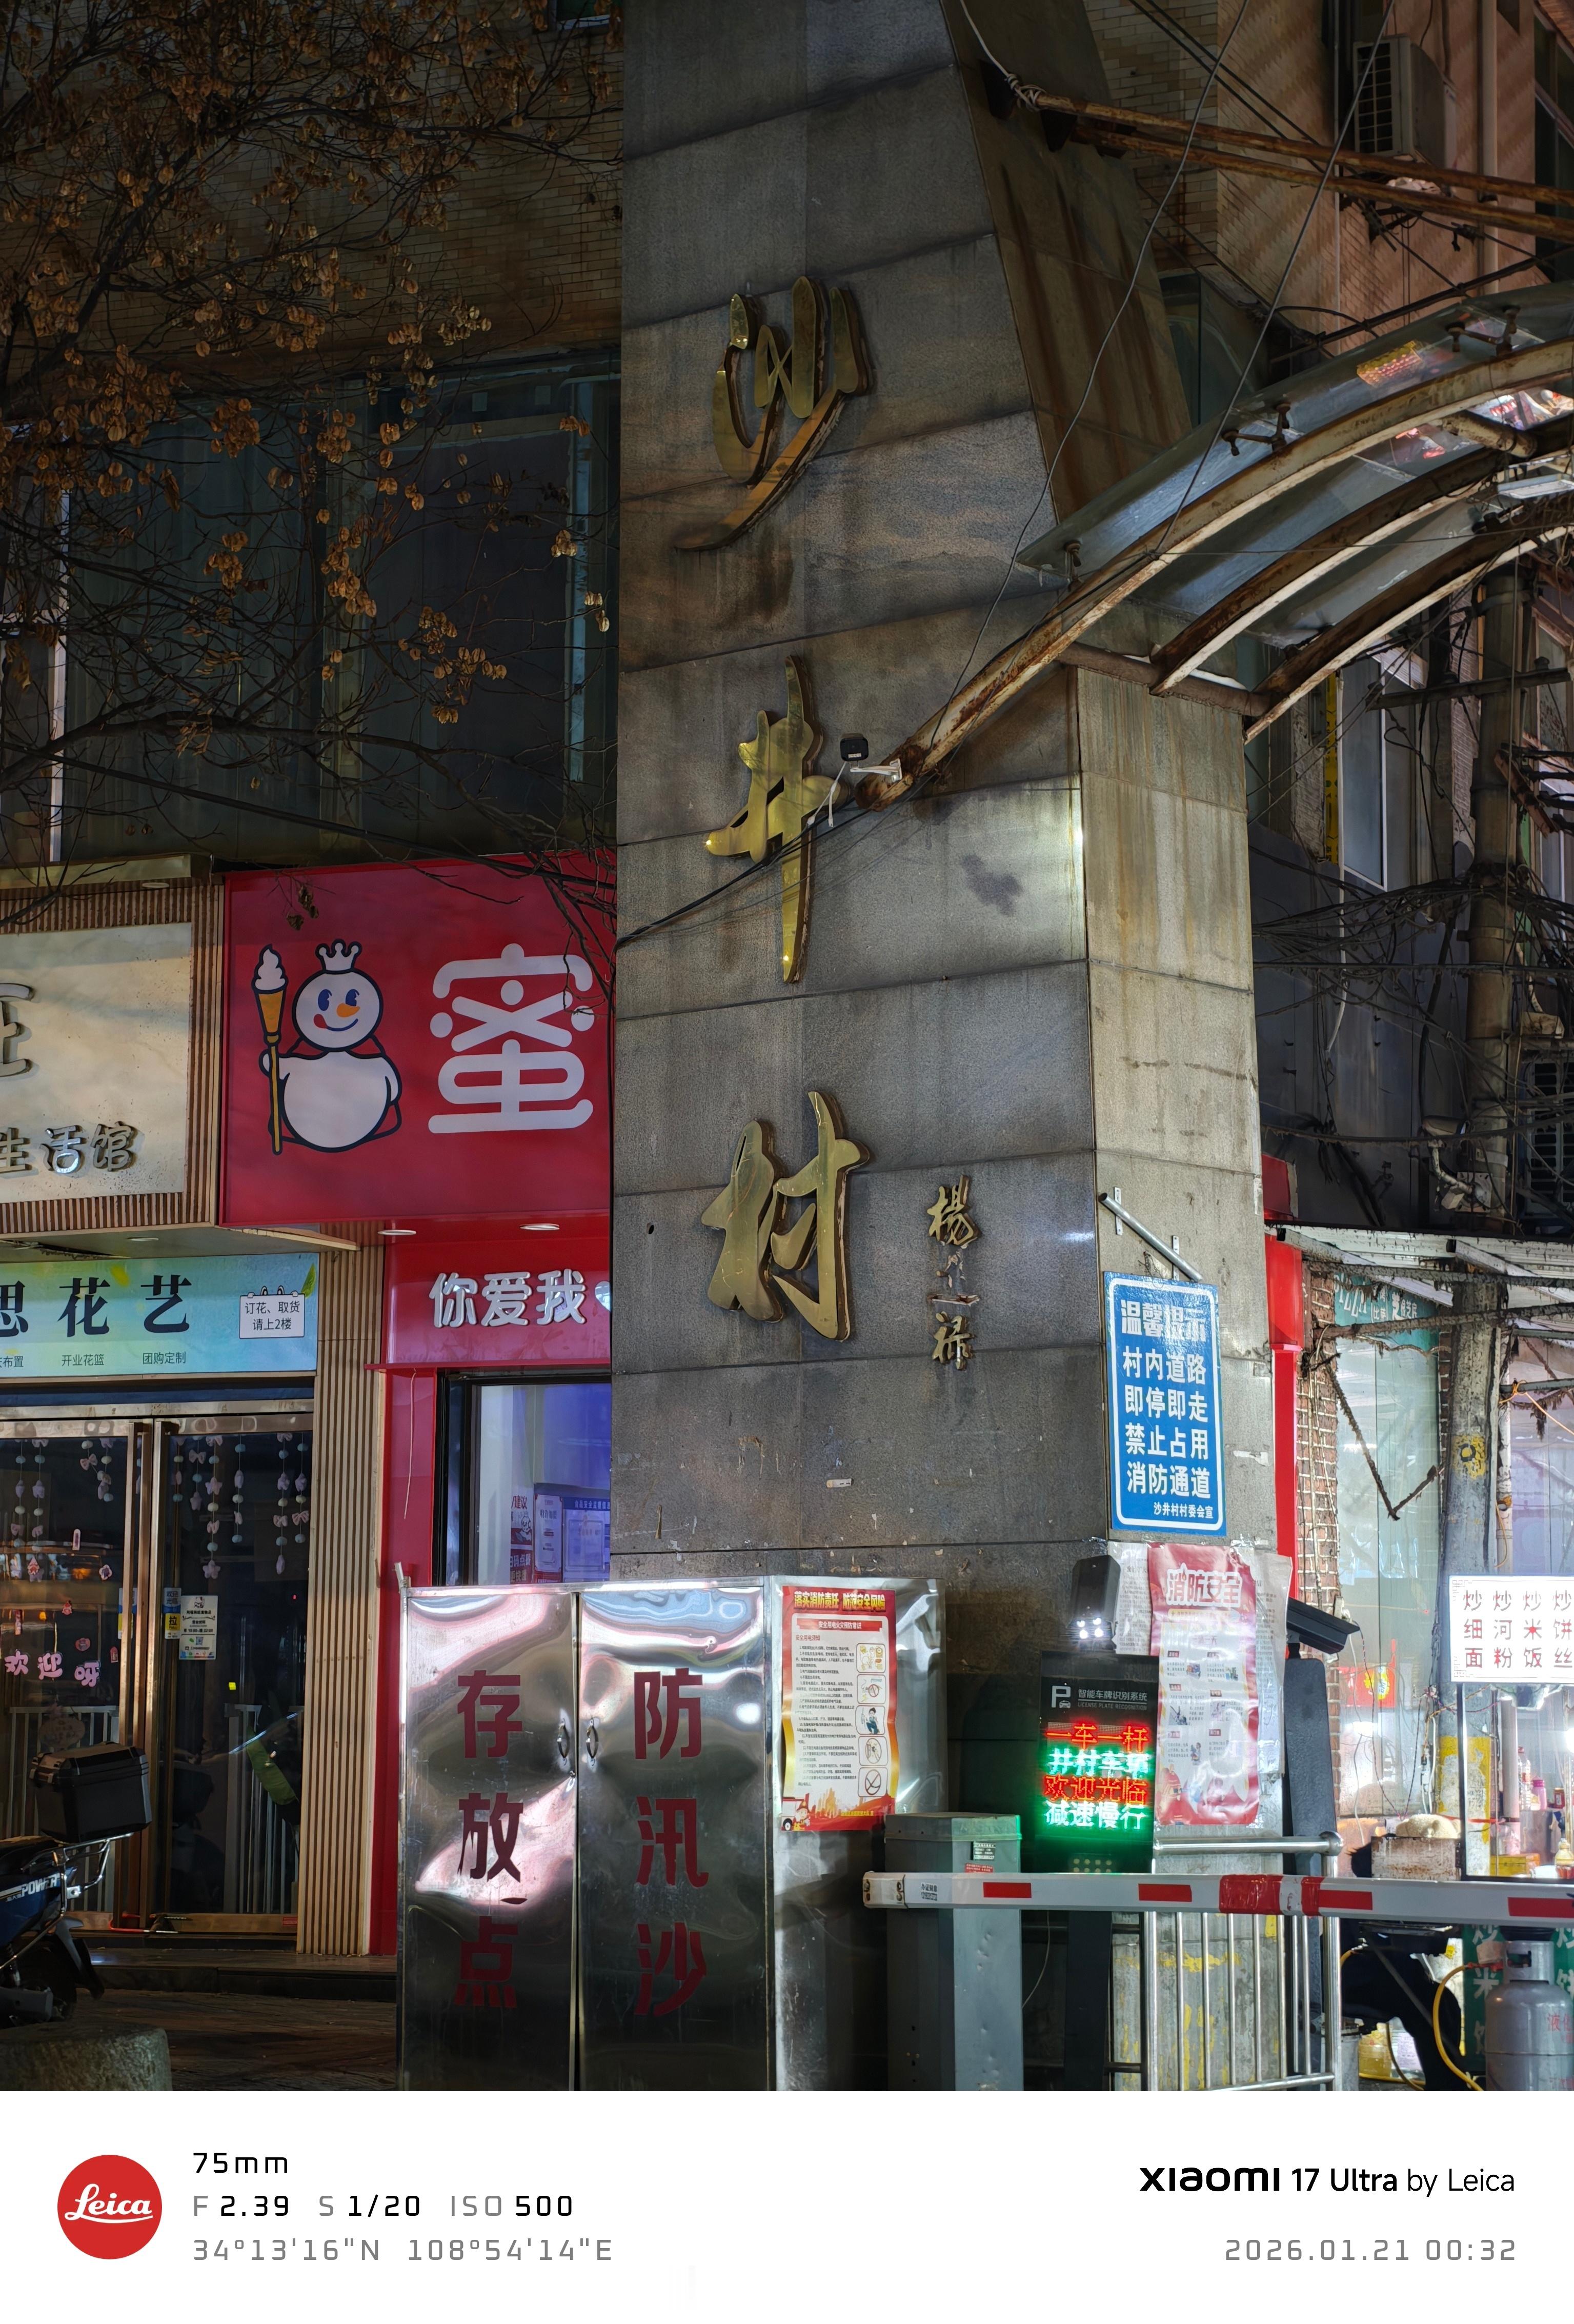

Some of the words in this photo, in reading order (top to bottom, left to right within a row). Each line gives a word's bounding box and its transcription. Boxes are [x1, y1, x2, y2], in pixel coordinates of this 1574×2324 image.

[428, 943, 594, 1133] 蜜
[245, 1300, 300, 1314] 订花、取货
[429, 1269, 586, 1328] 你爱我
[252, 1317, 292, 1331] 请上2楼
[1121, 1299, 1206, 1342] 温馨提示
[0, 1356, 24, 1368] 布置
[62, 1354, 105, 1367] 开业花篮
[143, 1351, 186, 1365] 团购定制
[1123, 1345, 1206, 1385] 村内道路
[1124, 1385, 1208, 1423] 即停即走
[1125, 1422, 1208, 1460] 禁止占用
[1127, 1461, 1210, 1498] 消防通道
[1154, 1501, 1214, 1519] 沙井村村委会宣
[794, 1591, 839, 1609] 落实消防责任
[842, 1592, 886, 1611] 防范安全风险
[1167, 1571, 1241, 1605] 消防安全
[169, 1616, 177, 1625] 拉
[1463, 1590, 1483, 1668] 炒细面
[1493, 1591, 1512, 1669] 炒河粉
[1523, 1591, 1543, 1668] 炒米饭
[1552, 1590, 1573, 1668] 炒饼丝
[4, 1651, 101, 1687] 欢迎呀
[1078, 1689, 1147, 1701] 智能车牌识别系统
[1046, 1723, 1149, 1753] 一车一杆
[1044, 1774, 1147, 1805] 欢迎光临
[1044, 1800, 1147, 1830] 减速慢行
[454, 1669, 524, 2008] 存放点
[634, 1668, 709, 2016] 防汛沙
